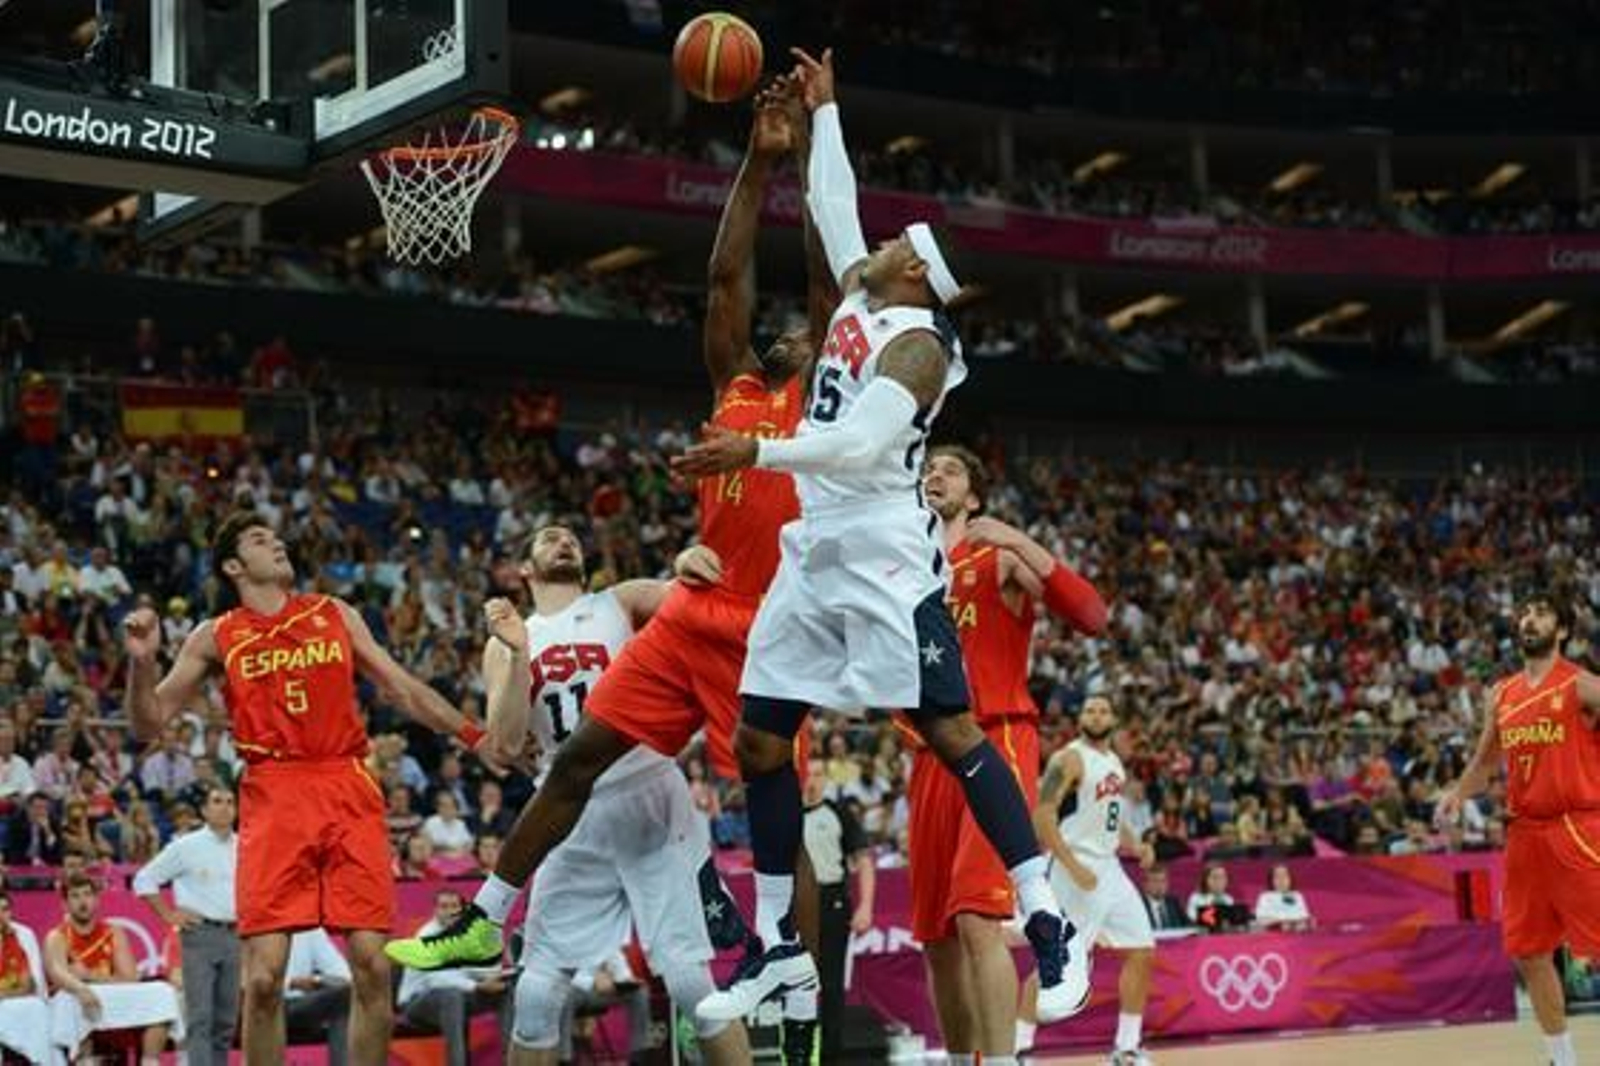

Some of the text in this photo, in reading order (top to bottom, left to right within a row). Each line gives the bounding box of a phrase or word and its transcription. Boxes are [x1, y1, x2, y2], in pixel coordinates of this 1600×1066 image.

[4, 98, 216, 159] London 2012
[664, 172, 735, 207] Lond
[1548, 242, 1600, 272] Lon
[823, 314, 871, 382] SA
[809, 364, 842, 422] 5
[716, 469, 743, 506] 14
[240, 636, 343, 680] ESPAÑA
[285, 680, 309, 714] 5
[542, 681, 588, 742] 11
[1518, 754, 1534, 783] 7
[1106, 801, 1120, 832] 8
